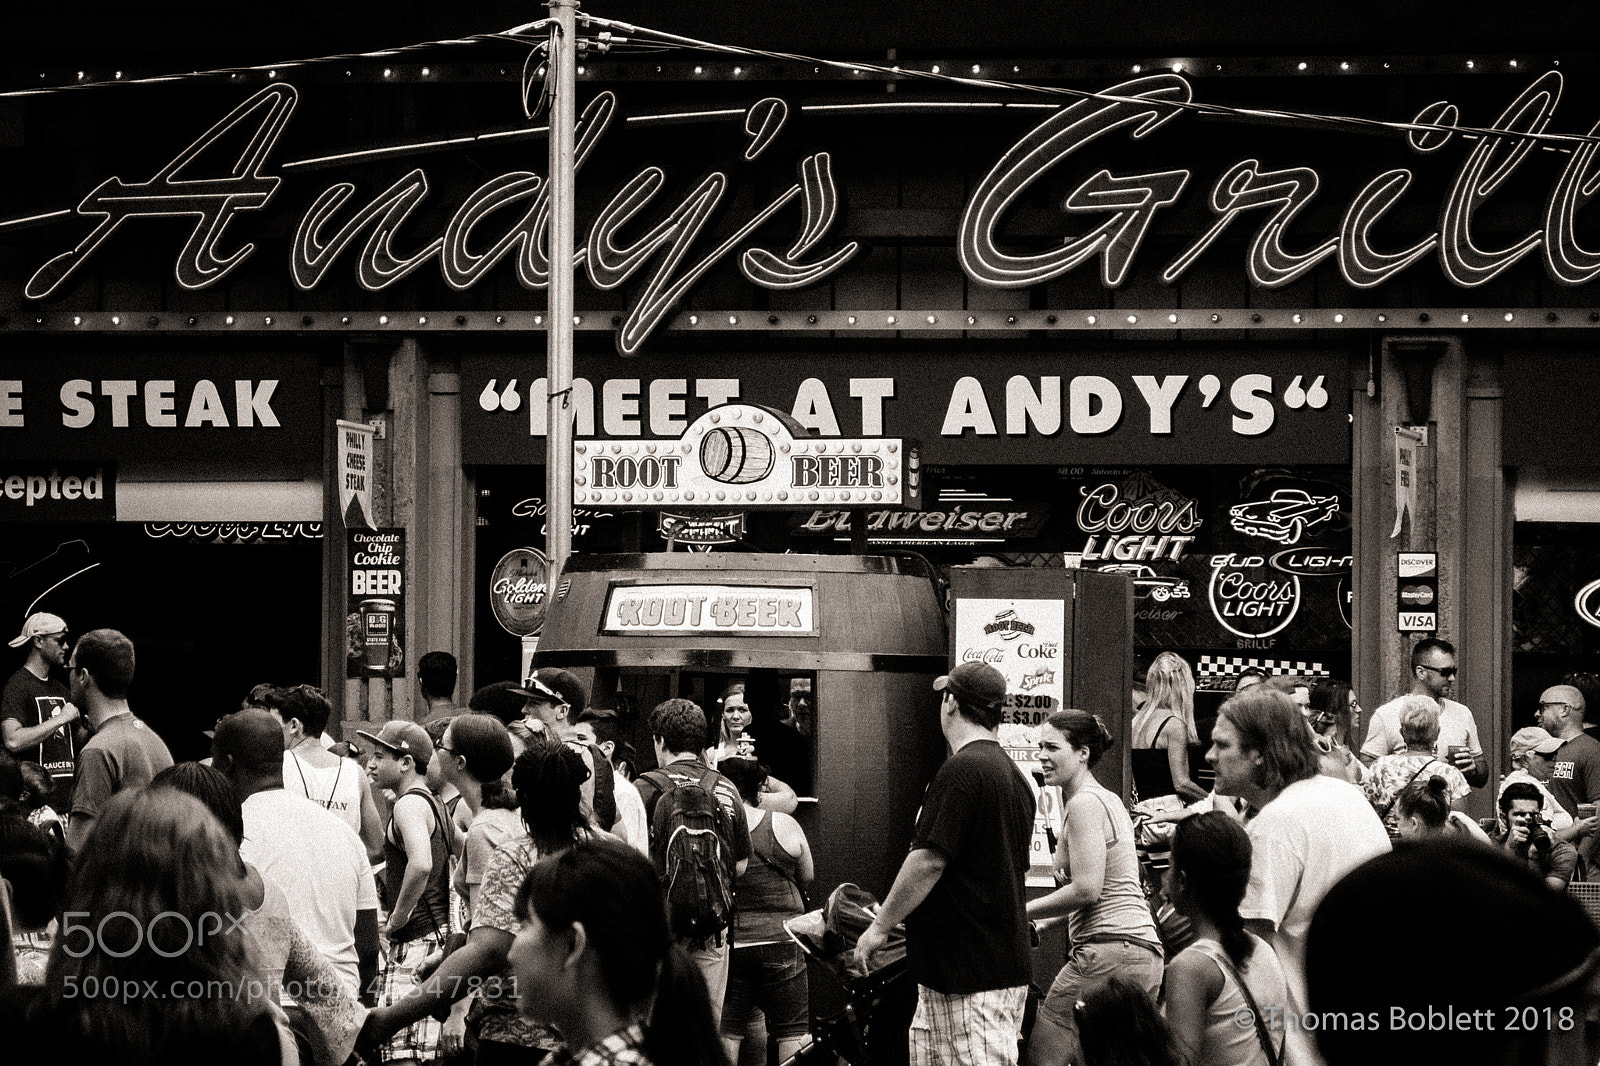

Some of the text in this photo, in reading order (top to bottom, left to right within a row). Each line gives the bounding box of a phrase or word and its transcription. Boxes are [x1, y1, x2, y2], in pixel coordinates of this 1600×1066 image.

[25, 82, 858, 354] Andy's
[60, 379, 281, 428] STEAK
[790, 377, 894, 436] AT
[346, 431, 366, 450] PHILLY
[346, 452, 366, 471] CHEESE
[345, 472, 366, 492] STEAK
[591, 455, 885, 490] ROOT BEER
[0, 467, 103, 506] cepted
[1077, 483, 1204, 533] Coors
[353, 533, 400, 543] Chocolate
[1081, 534, 1196, 561] LIGHT
[353, 551, 401, 566] Cookie
[367, 542, 393, 556] Chip
[1210, 553, 1264, 567] BUD
[352, 569, 402, 595] BEER
[493, 577, 547, 594] Golden
[1219, 571, 1295, 600] Coors
[503, 593, 544, 604] LIGHT
[617, 591, 802, 627] ROOT BEER
[1134, 605, 1184, 621] eiser
[1223, 601, 1290, 617] LIGHT
[983, 620, 1035, 636] ROOT BEER
[1402, 615, 1434, 627] VISA
[1017, 643, 1058, 659] Coke
[1022, 669, 1053, 688] Sprite
[1015, 693, 1051, 709] $2.00
